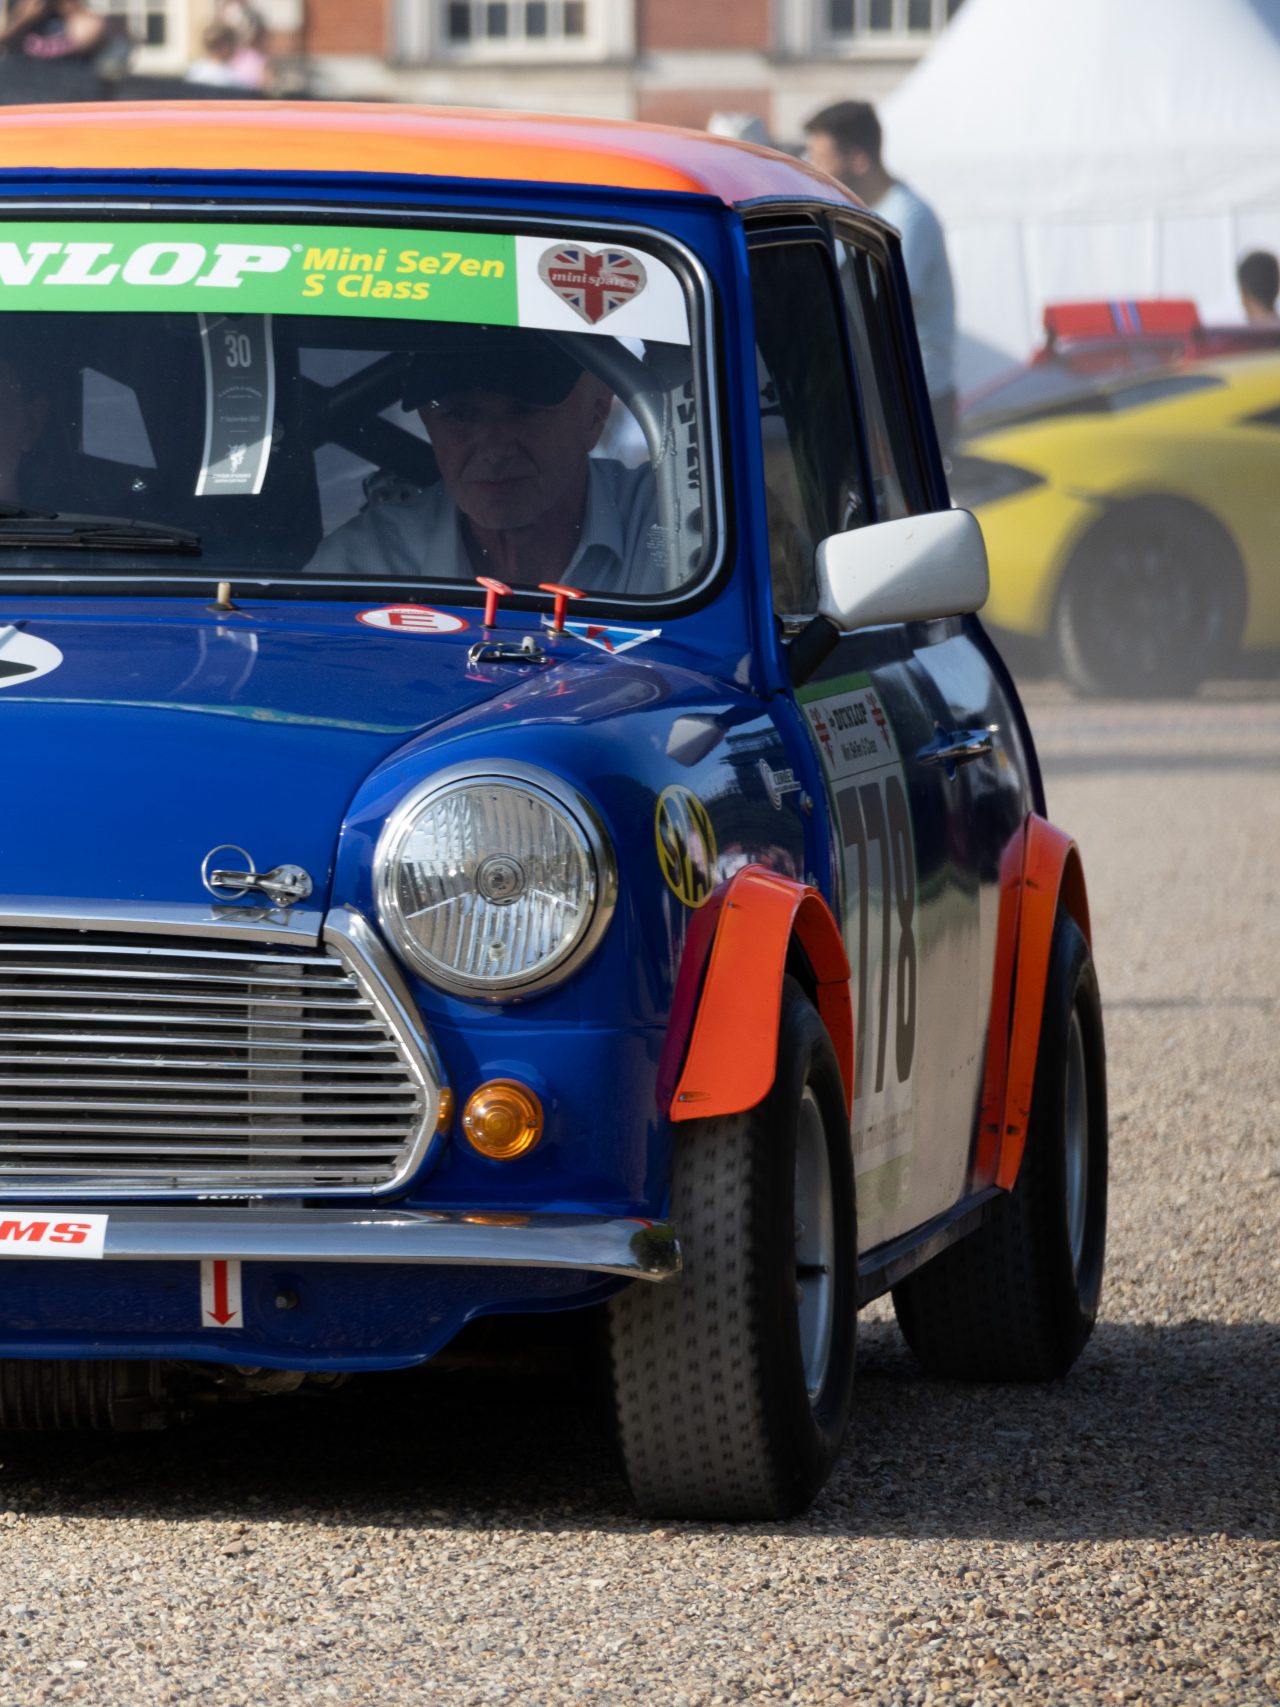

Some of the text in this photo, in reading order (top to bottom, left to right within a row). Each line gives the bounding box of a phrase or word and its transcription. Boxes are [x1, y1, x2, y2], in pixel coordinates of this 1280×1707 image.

[303, 248, 505, 278] Mini Se7en
[303, 274, 430, 300] S Class
[224, 334, 252, 368] 30
[832, 702, 868, 730] DUNLOP
[835, 775, 917, 1100] 778
